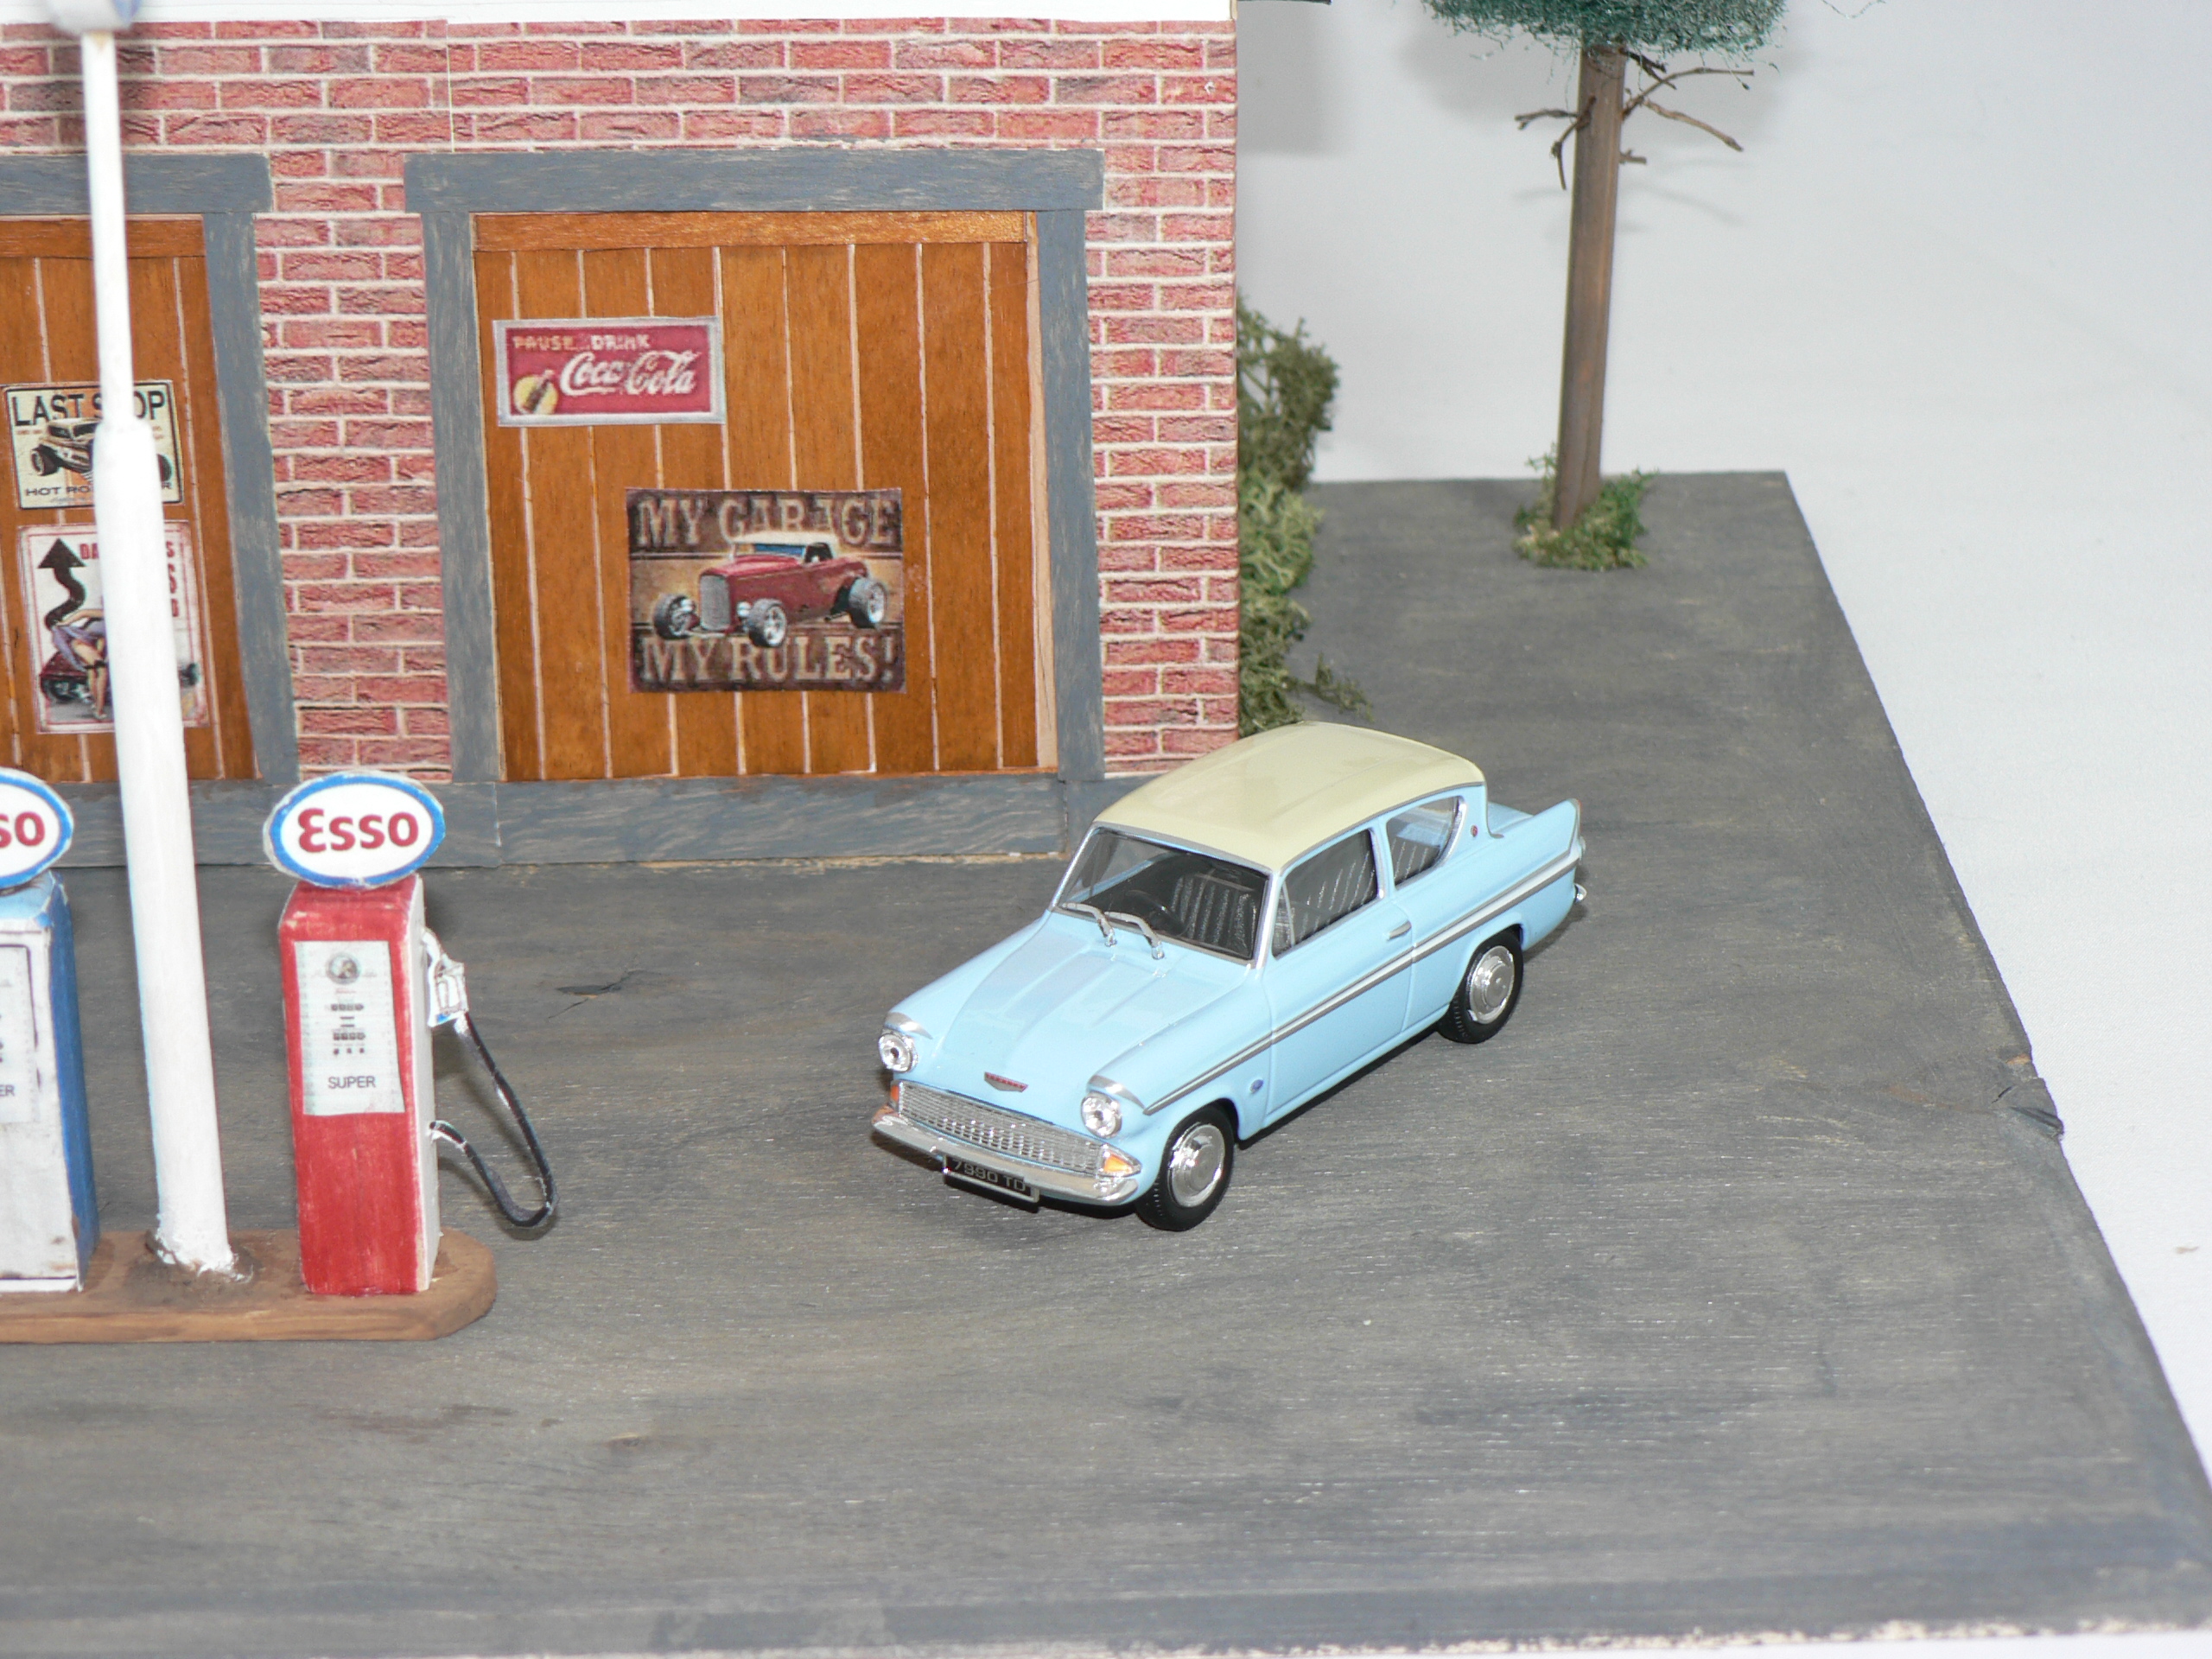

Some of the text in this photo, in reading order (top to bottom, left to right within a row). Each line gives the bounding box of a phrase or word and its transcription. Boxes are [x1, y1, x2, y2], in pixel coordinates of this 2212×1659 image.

[12, 390, 166, 426] LAST SOP
[26, 485, 92, 496] HOT RO
[638, 497, 893, 545] MY GARAGE
[641, 634, 895, 683] MY RULES!
[327, 1076, 376, 1089] SUPER
[953, 1159, 1026, 1192] 7990 TD
